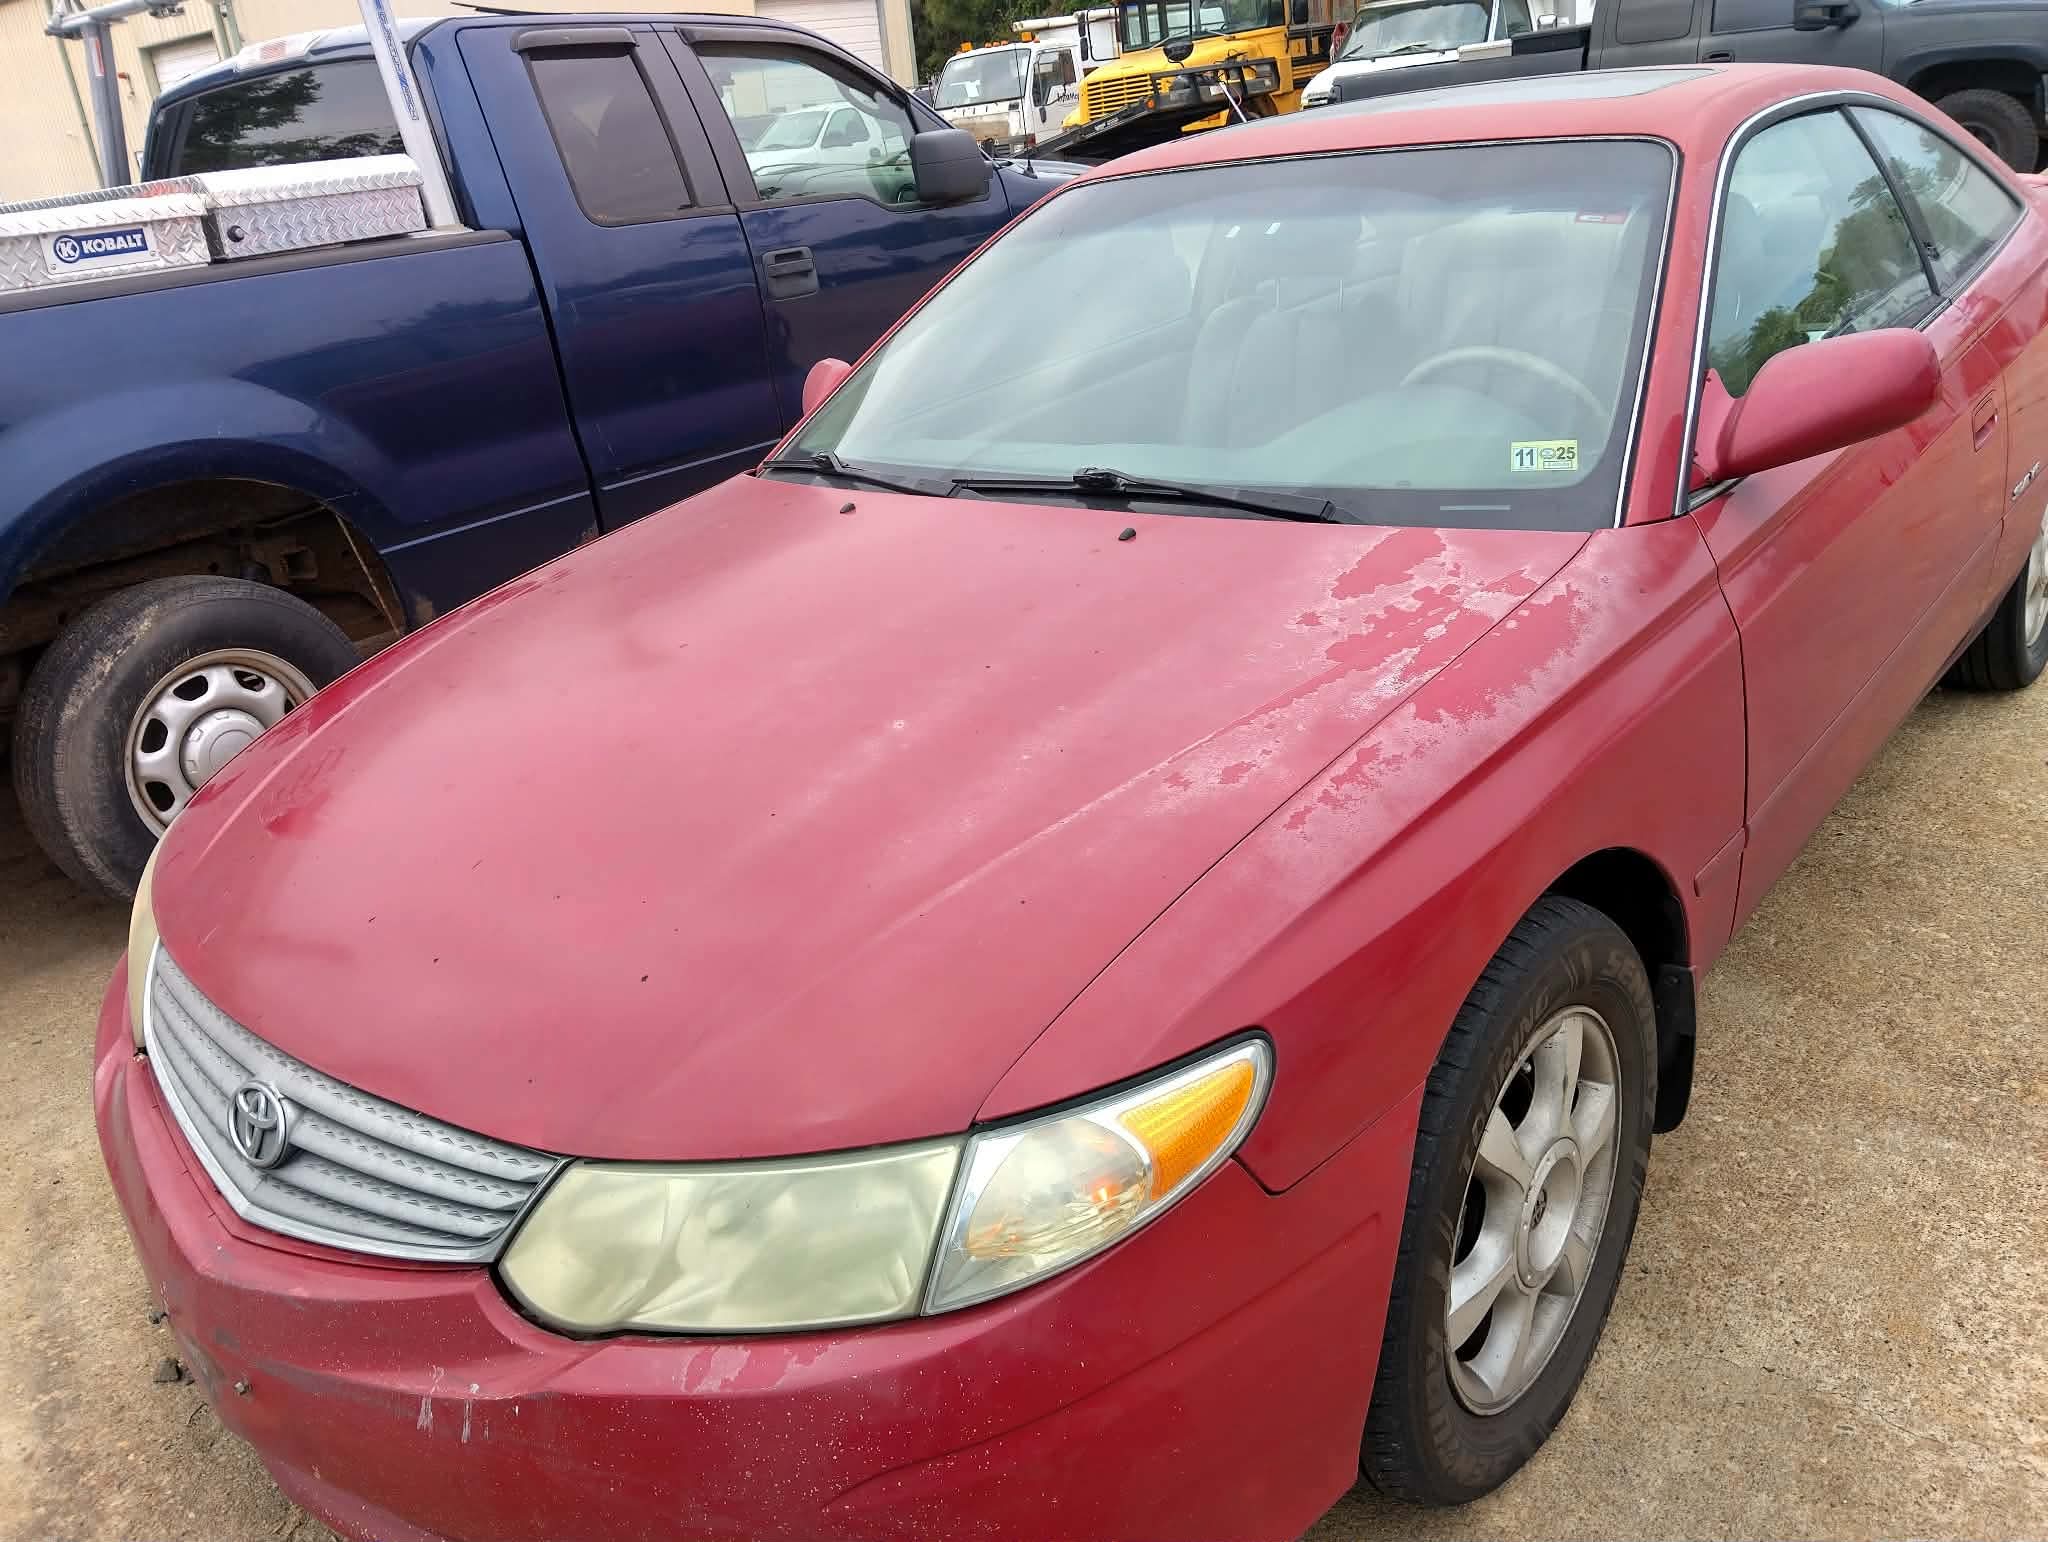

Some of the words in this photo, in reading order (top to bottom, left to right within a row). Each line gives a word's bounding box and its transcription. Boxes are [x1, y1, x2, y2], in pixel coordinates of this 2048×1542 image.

[81, 233, 143, 254] KOBALT
[1515, 448, 1534, 466] 11
[1556, 446, 1576, 460] 25
